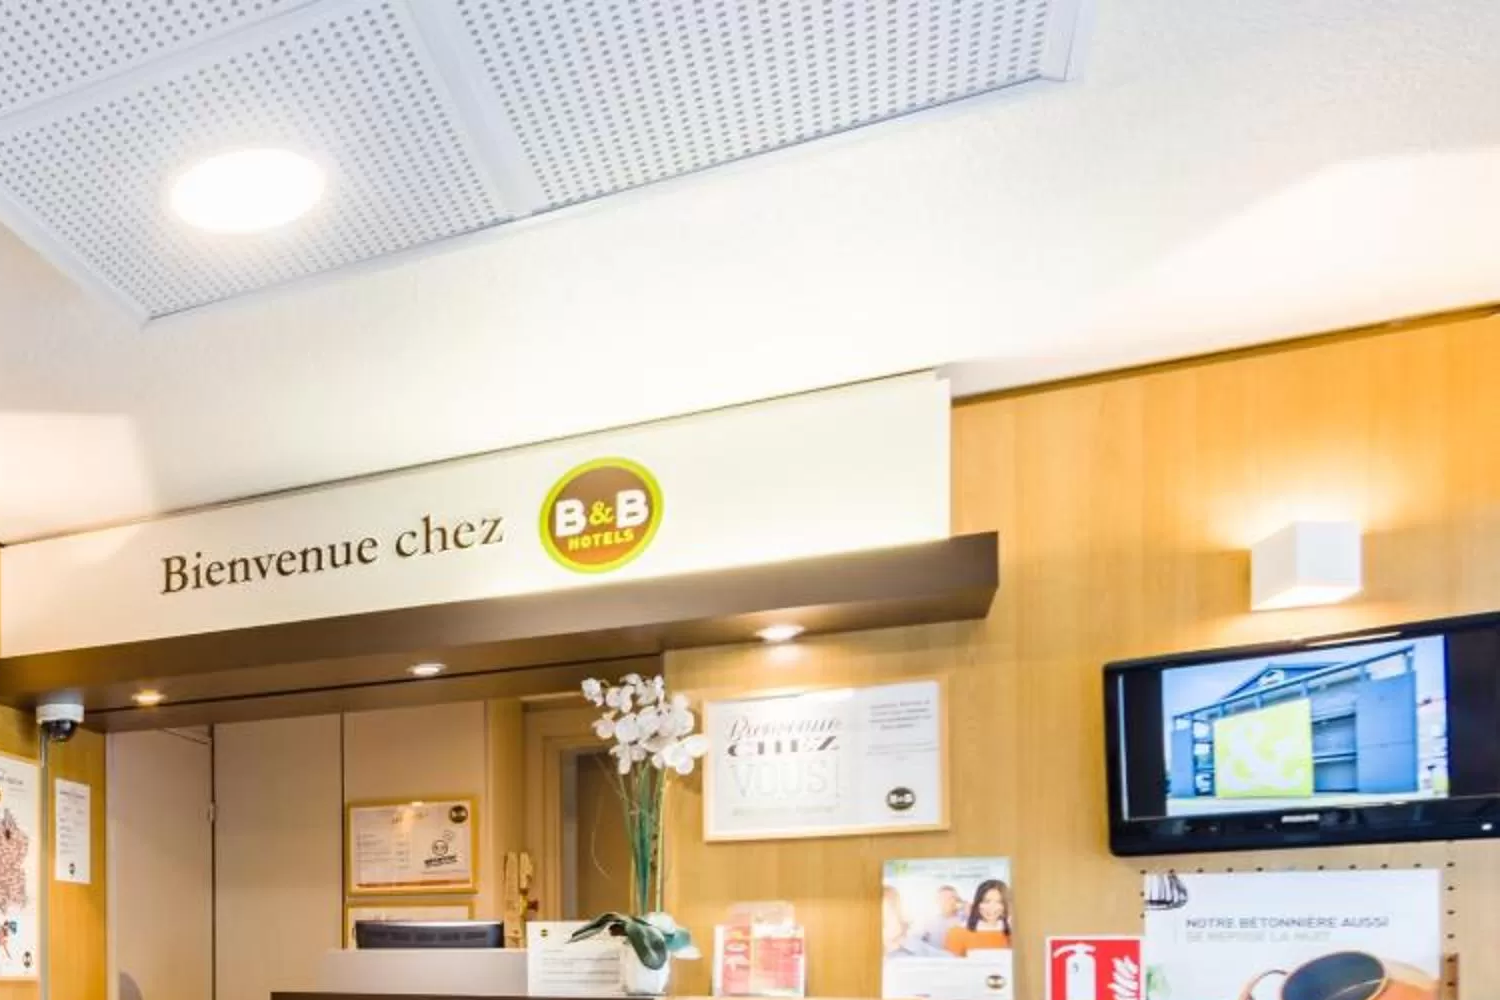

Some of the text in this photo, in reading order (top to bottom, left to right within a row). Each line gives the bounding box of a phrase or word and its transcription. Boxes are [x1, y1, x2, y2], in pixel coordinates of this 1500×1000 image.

[567, 529, 635, 551] HOTELS
[160, 514, 505, 595] Bienvenue chez
[1186, 916, 1235, 929] NOTRE
[1341, 915, 1390, 928] AUSSI
